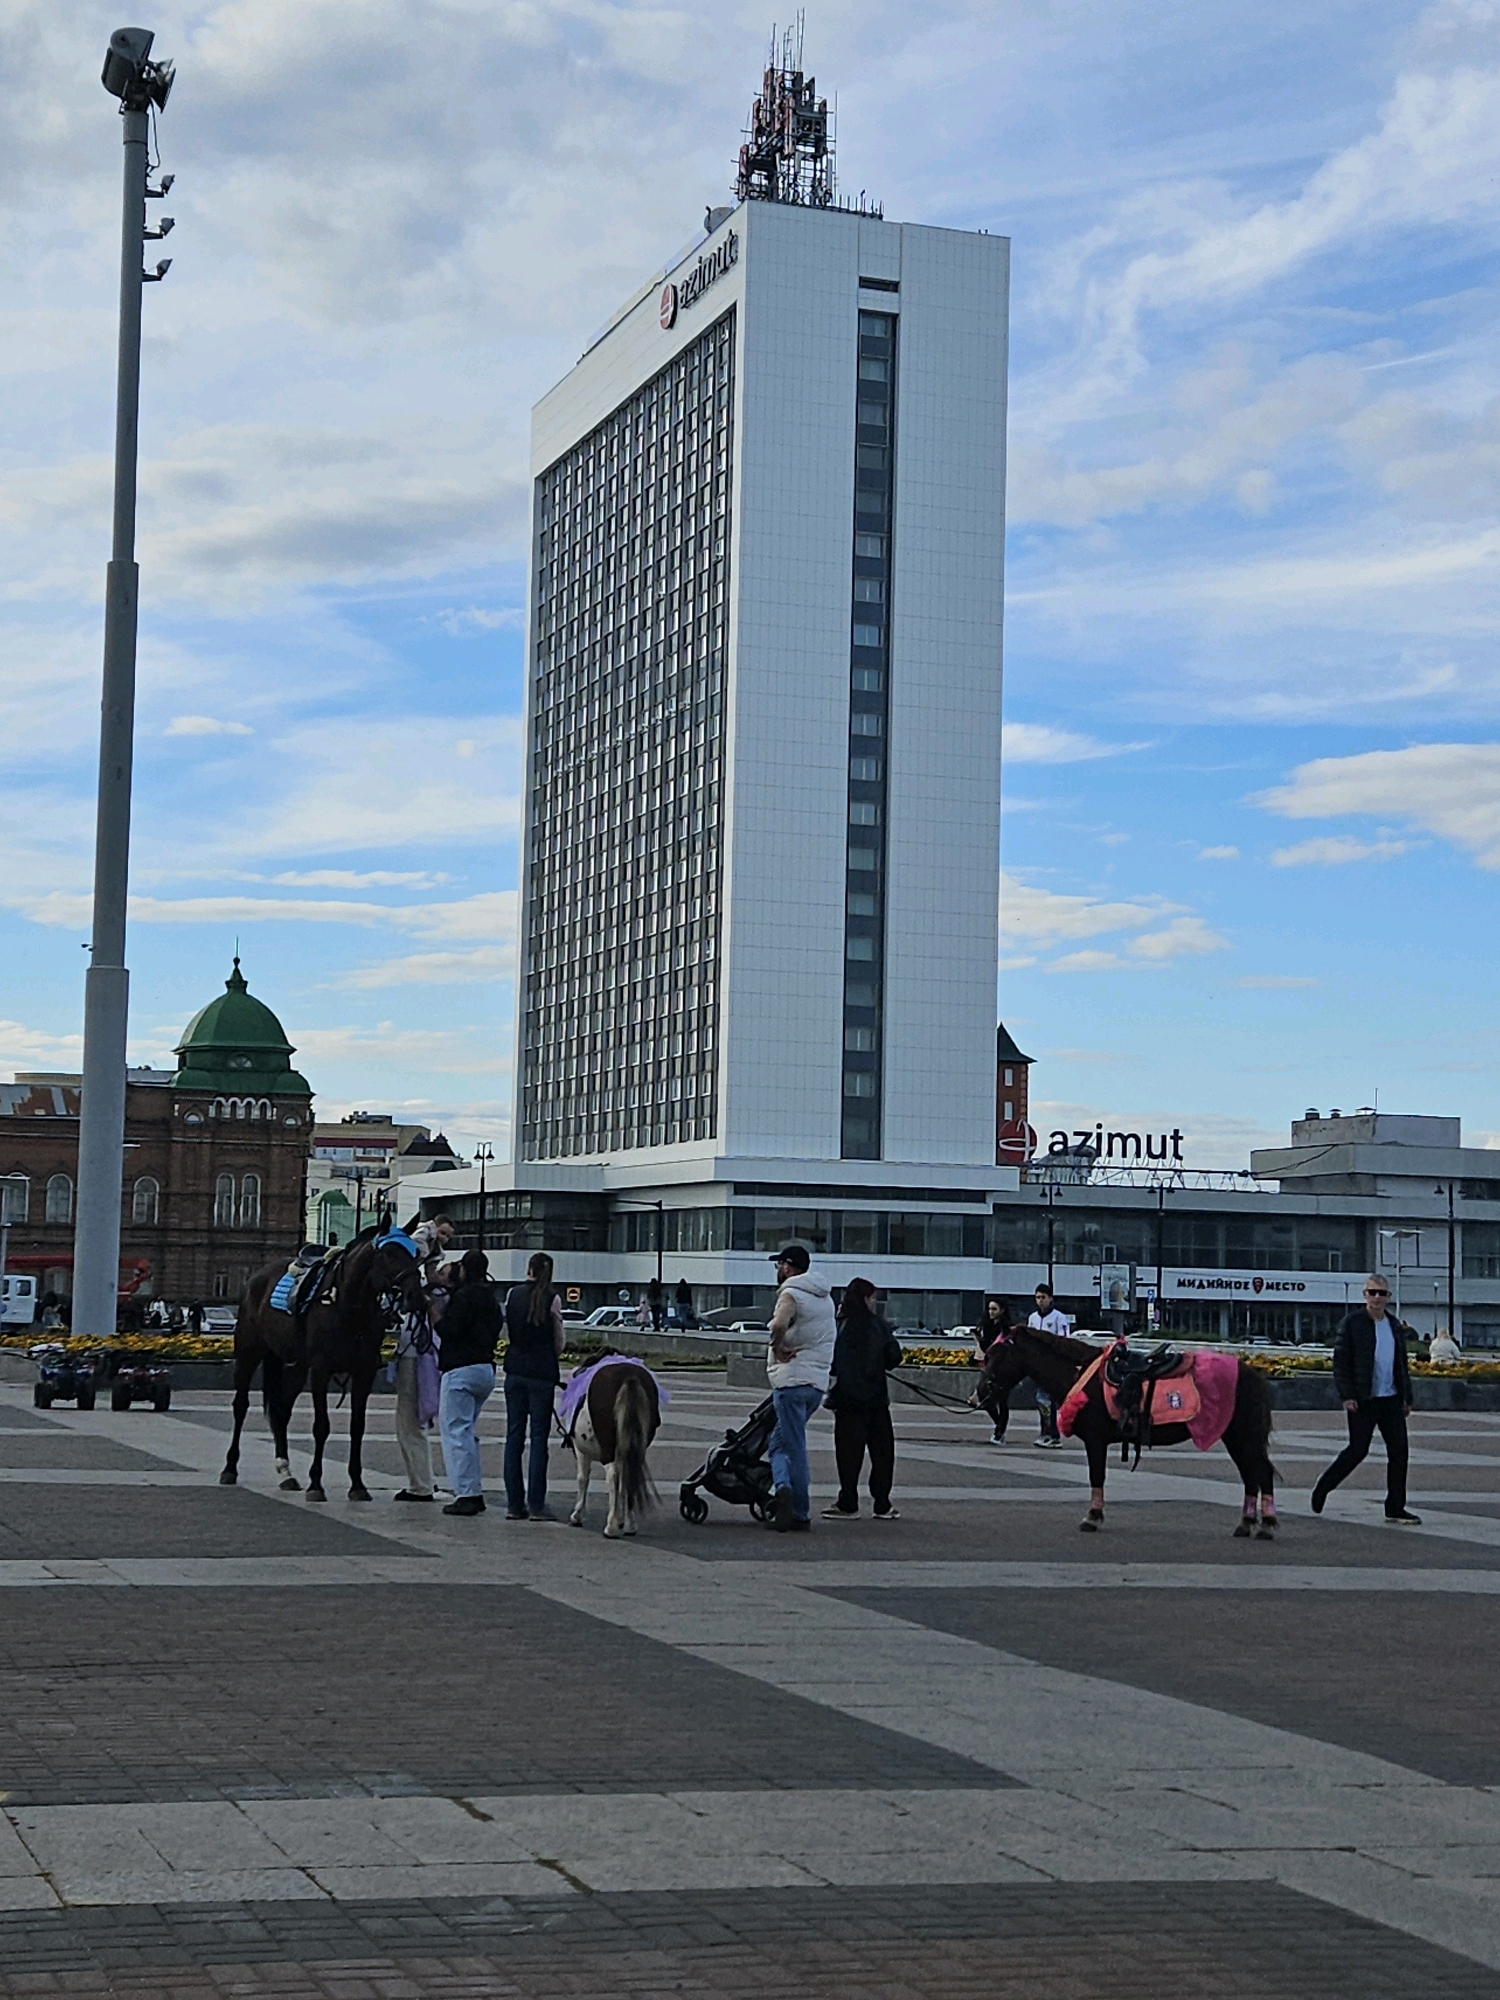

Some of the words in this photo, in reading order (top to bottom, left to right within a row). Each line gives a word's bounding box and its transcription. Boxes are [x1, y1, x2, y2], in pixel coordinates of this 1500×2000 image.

[680, 228, 739, 309] azimut
[1048, 1122, 1184, 1161] azimut
[1265, 1280, 1307, 1292] МЕСТО
